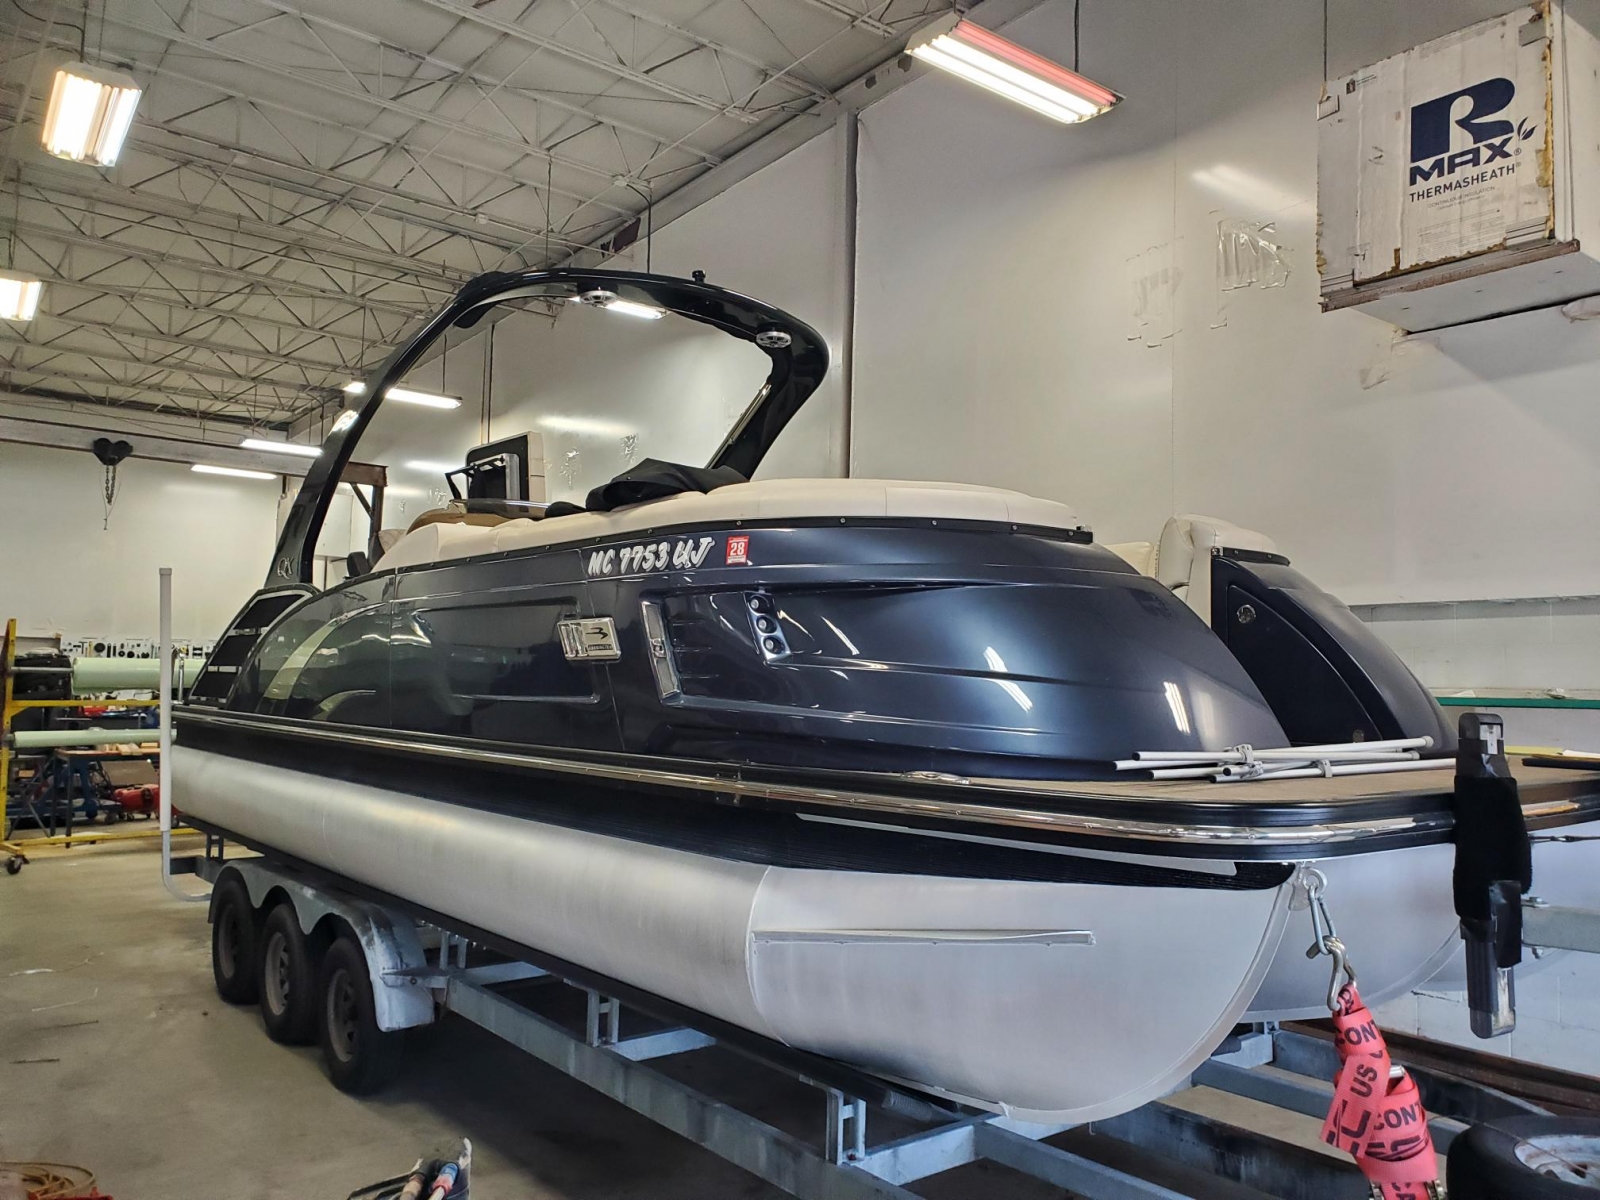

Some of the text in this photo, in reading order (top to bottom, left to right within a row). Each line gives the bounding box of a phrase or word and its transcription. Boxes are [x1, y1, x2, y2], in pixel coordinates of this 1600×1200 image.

[1411, 77, 1515, 163] R
[588, 536, 716, 577] MC 7753 UJ
[730, 542, 745, 556] 28
